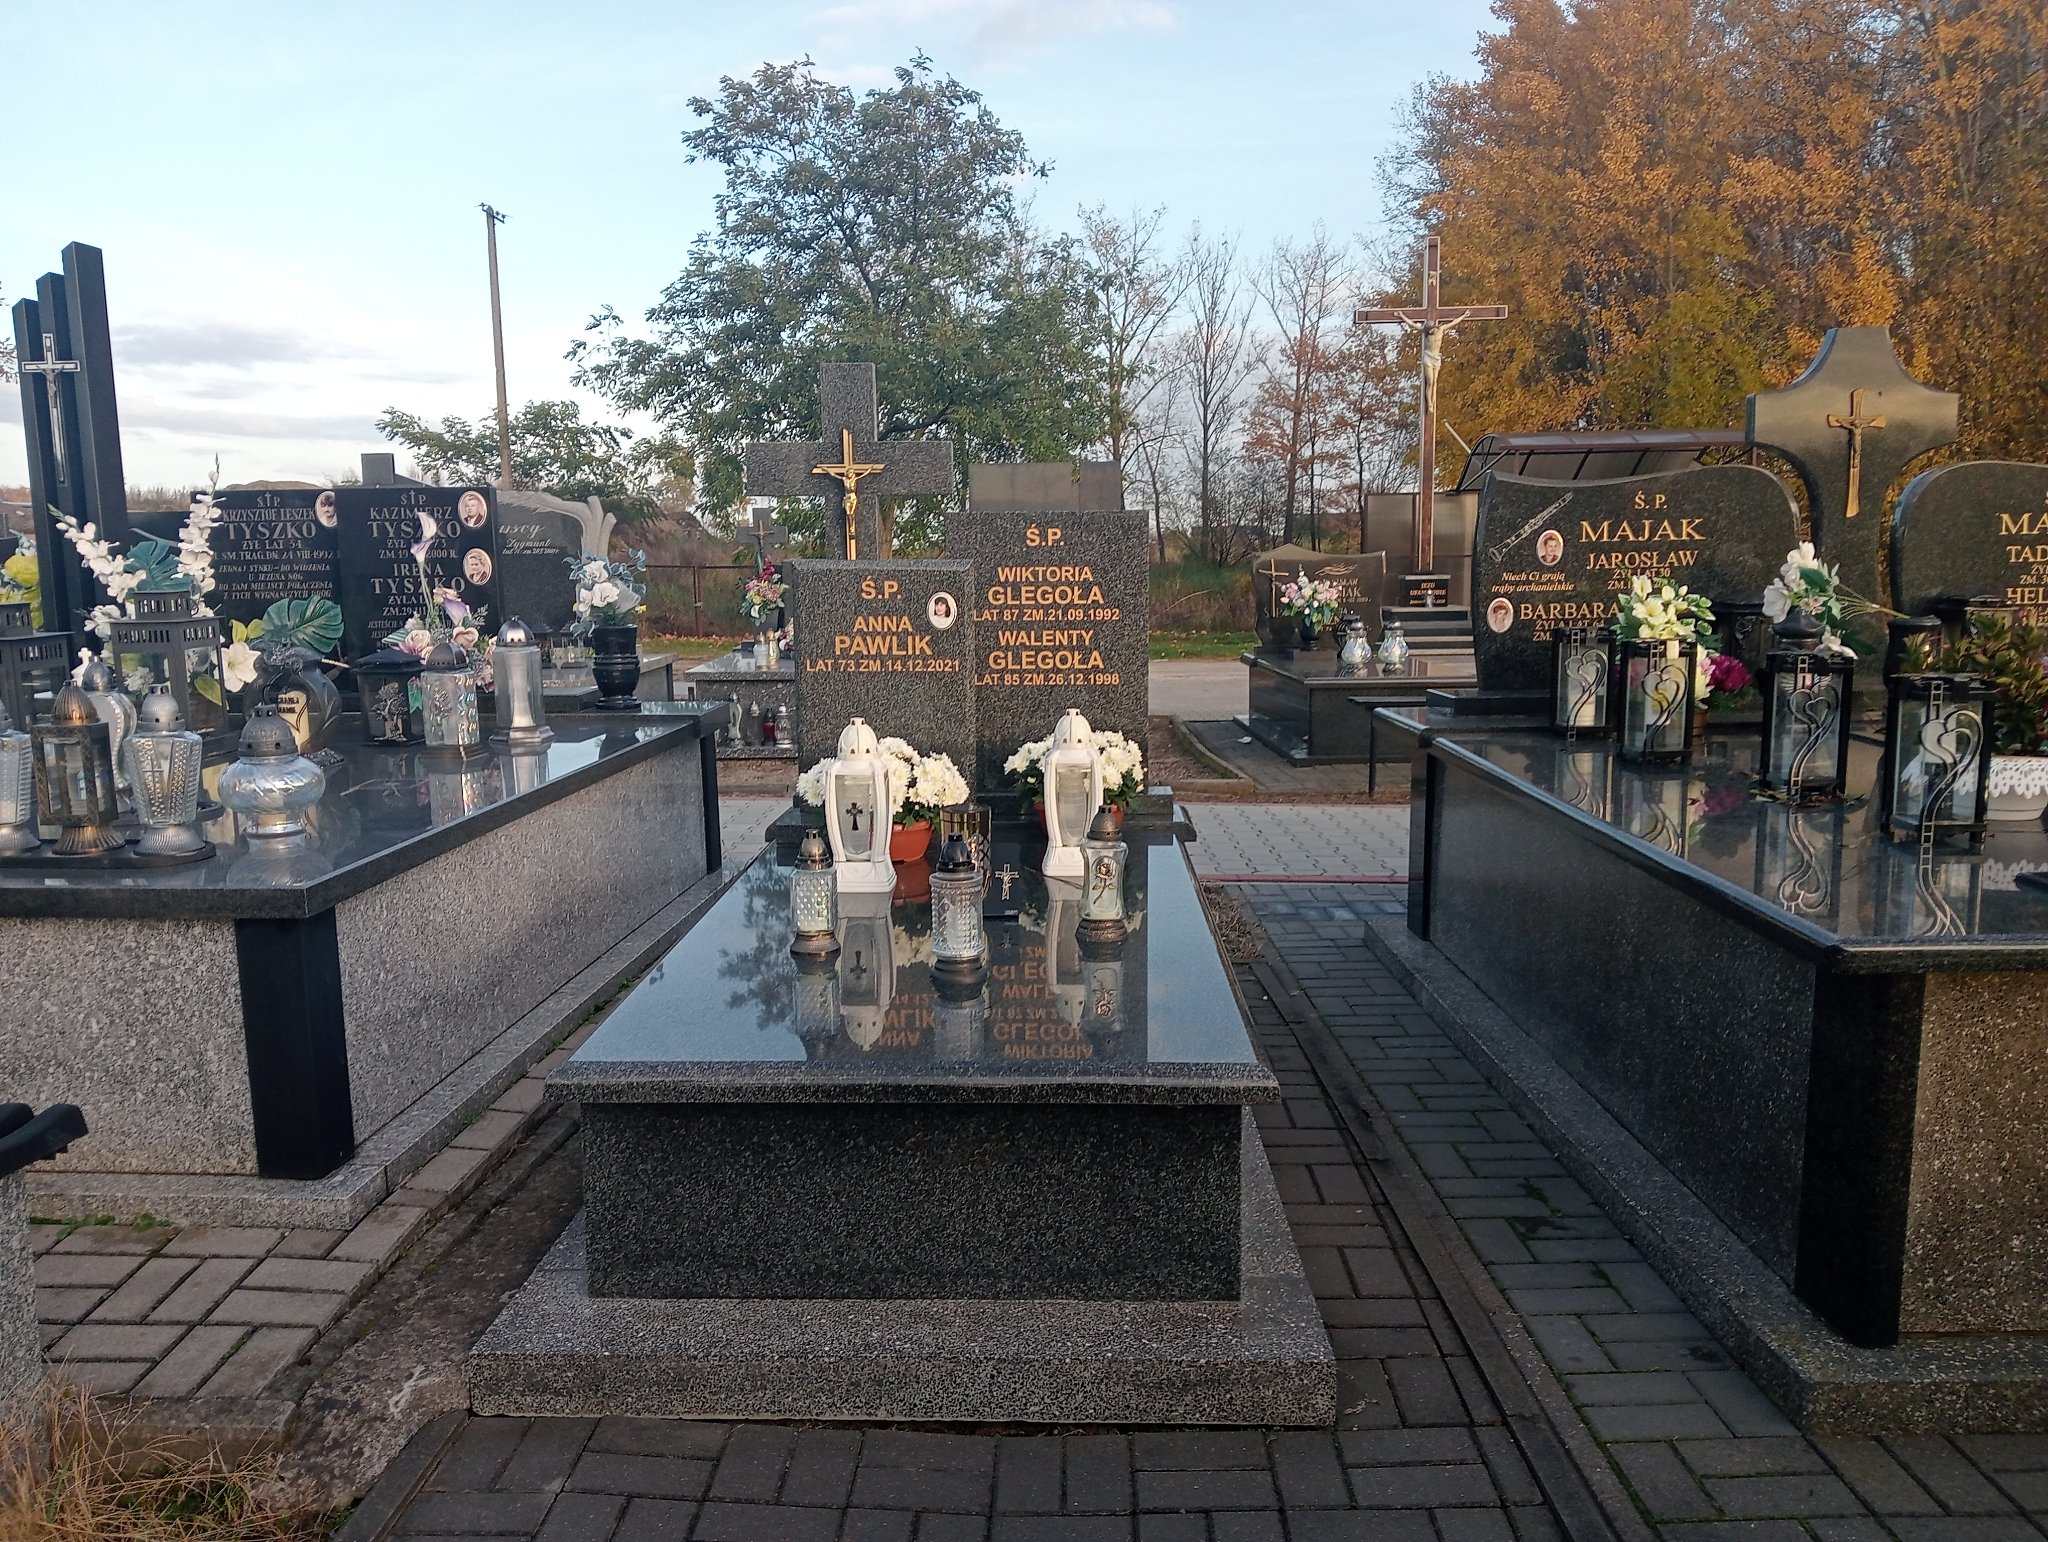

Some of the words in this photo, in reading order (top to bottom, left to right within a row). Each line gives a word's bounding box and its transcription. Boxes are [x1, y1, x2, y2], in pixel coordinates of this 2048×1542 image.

[225, 521, 317, 540] TYSZKO
[1579, 518, 1707, 542] MAJAK
[265, 540, 284, 549] LAT
[1586, 550, 1699, 570] JAROSŁAW
[393, 563, 444, 577] IRENA
[998, 566, 1094, 582] WIKTORIA
[1501, 571, 1527, 581] Niech
[1659, 567, 1671, 577] 30
[370, 577, 466, 595] TYSZKO
[987, 585, 1105, 606] GLEGOŁA
[973, 609, 1000, 621] LAT
[1003, 609, 1019, 621] 87
[1022, 608, 1120, 622] ZM.21.09.1992
[1519, 601, 1620, 620] BARBARA
[853, 615, 913, 632] ANNA
[835, 634, 933, 656] PAWLIK
[998, 630, 1094, 646] WALENTY
[806, 659, 833, 672] LAT
[838, 659, 855, 672] 73
[859, 658, 960, 672] ZM.14.12.2021
[988, 649, 1105, 670] GLEGOŁA
[974, 674, 1000, 686] LAT
[1004, 674, 1020, 686] 85
[1023, 673, 1120, 686] ZM.26.12.1998
